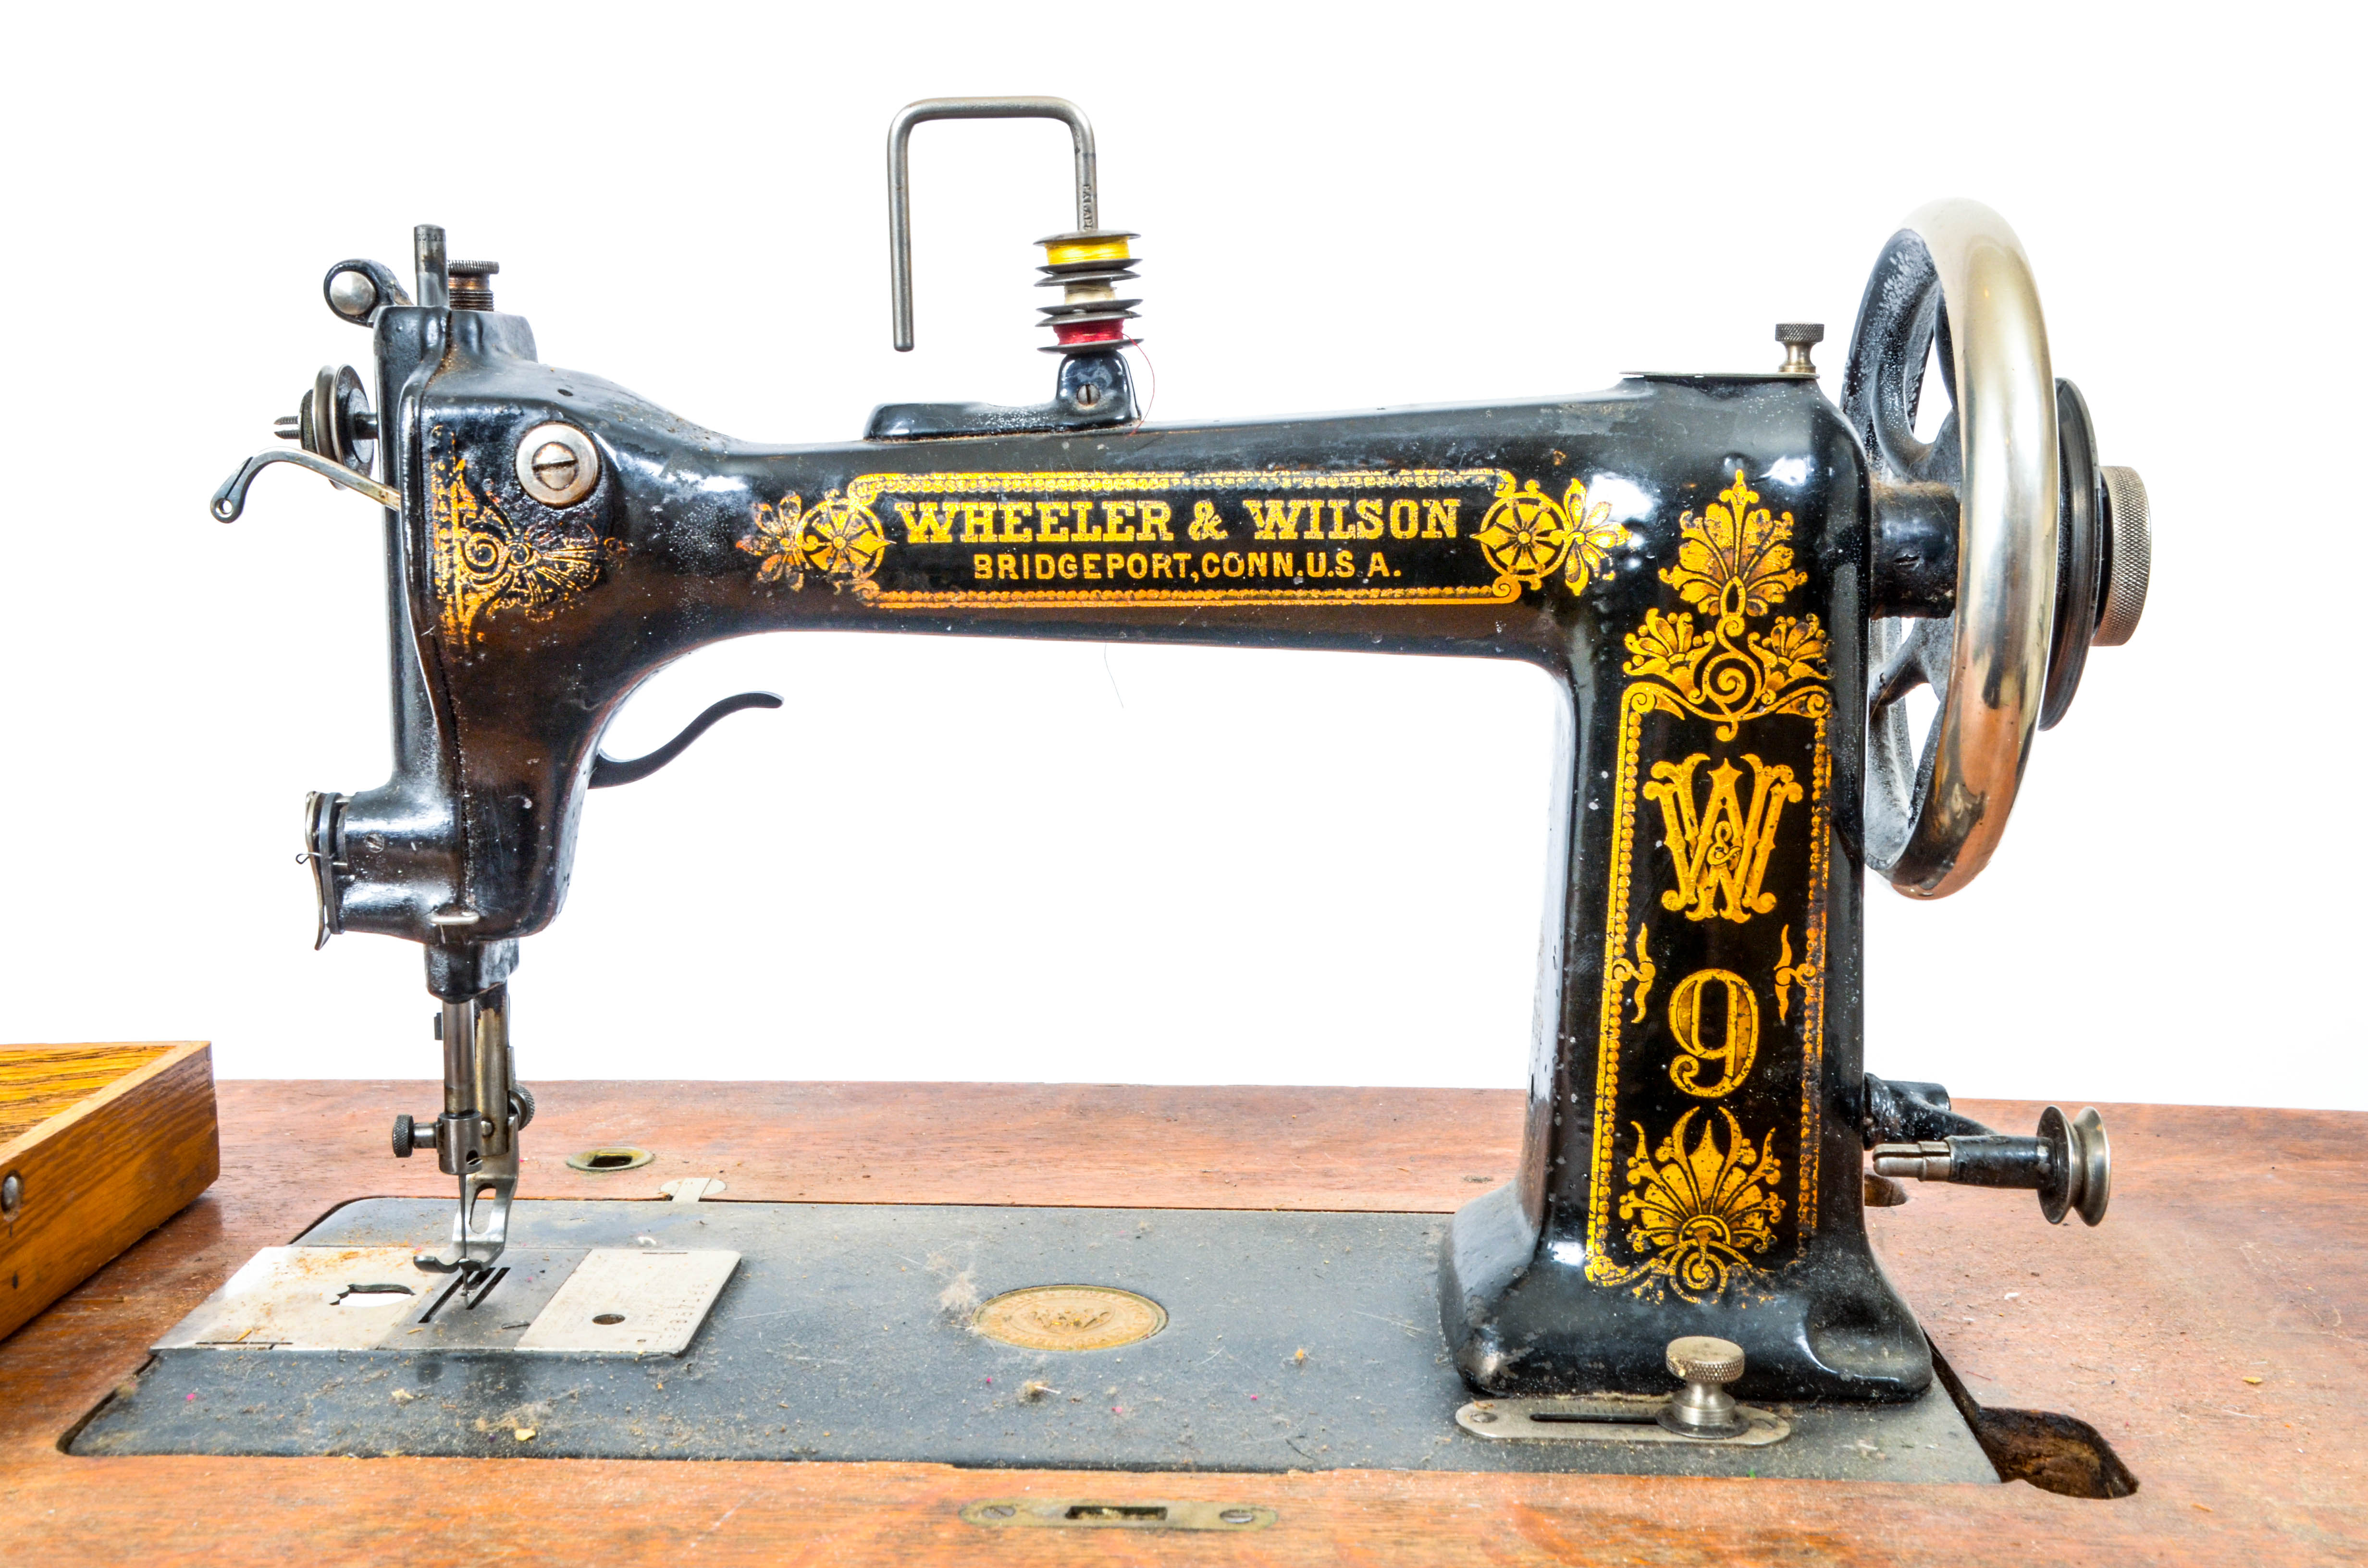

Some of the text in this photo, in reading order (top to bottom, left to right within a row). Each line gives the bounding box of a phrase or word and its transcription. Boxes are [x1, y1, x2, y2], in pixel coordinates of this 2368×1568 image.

[894, 498, 1461, 543] WHEELER & WILSON
[1668, 968, 1759, 1098] 9
